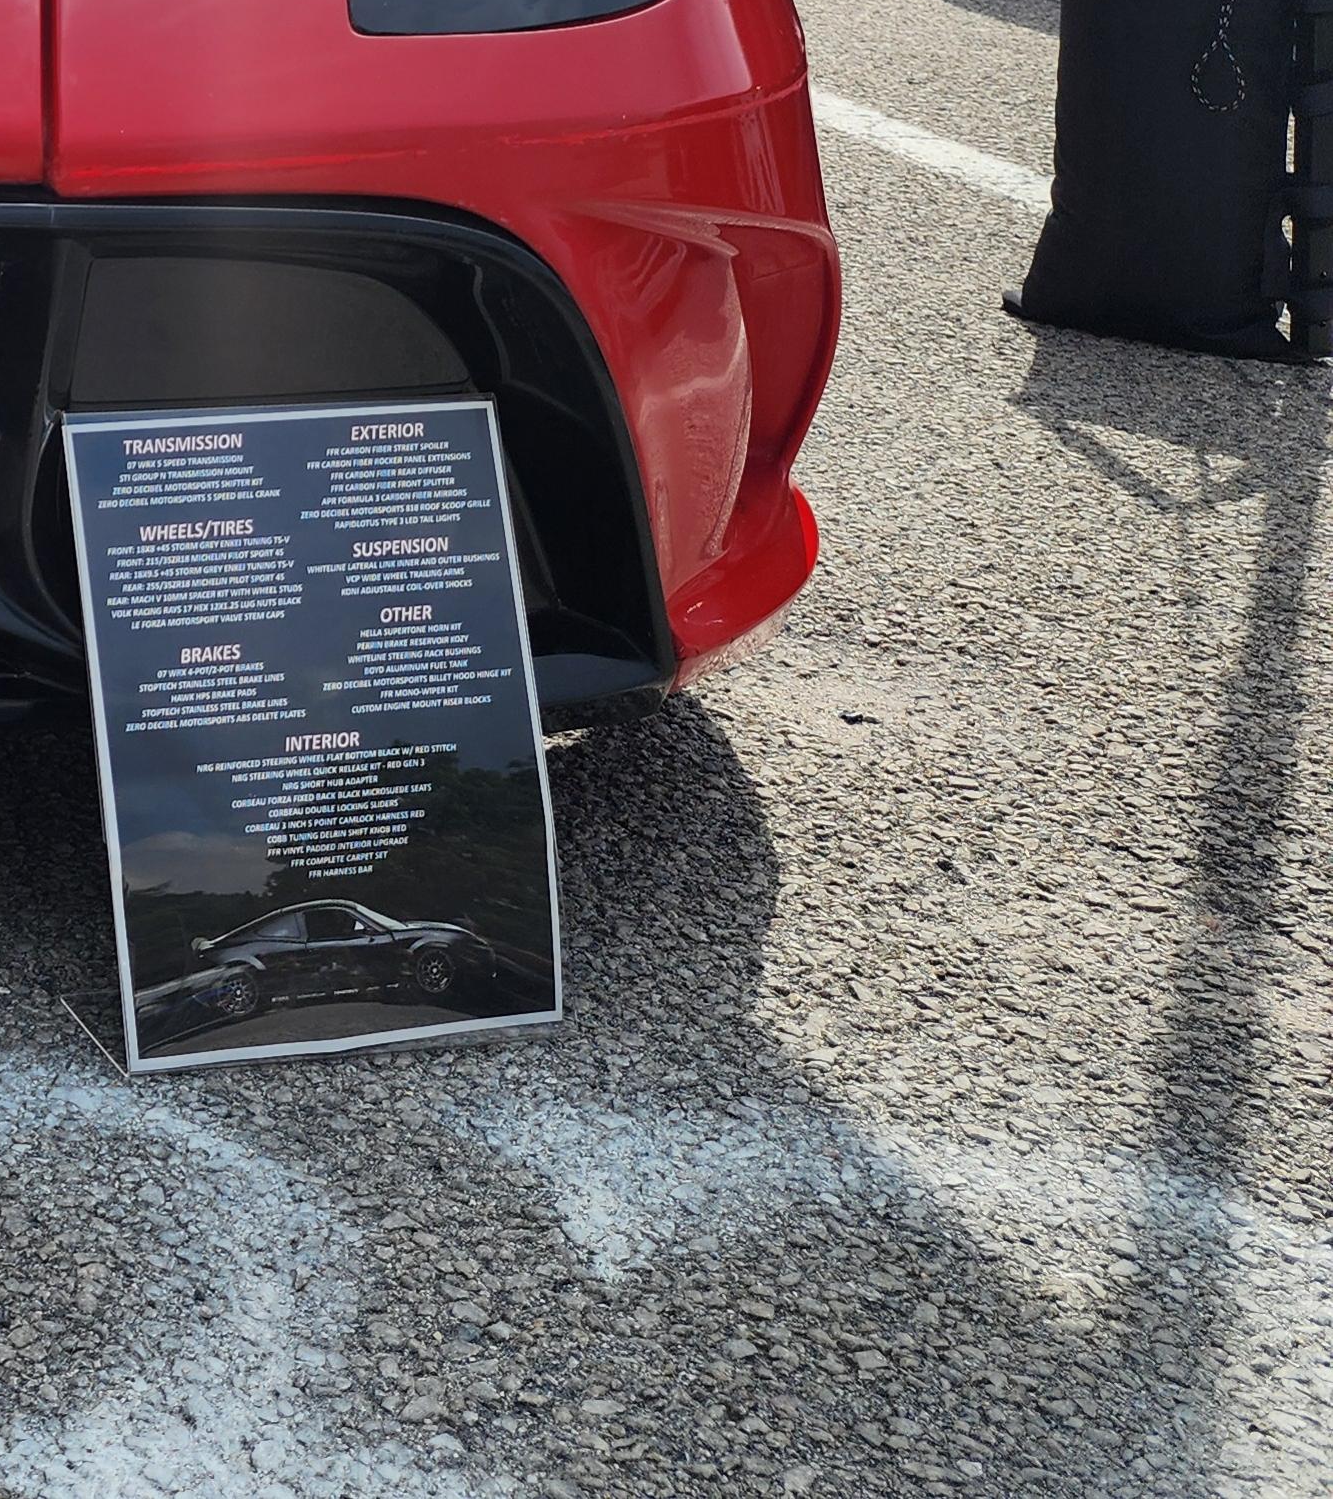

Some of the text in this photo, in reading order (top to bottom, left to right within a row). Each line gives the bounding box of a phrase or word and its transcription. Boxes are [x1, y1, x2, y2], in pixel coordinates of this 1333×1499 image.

[350, 422, 424, 441] EXTERIOR
[123, 433, 242, 454] TRANSMISSION
[139, 518, 253, 541] WHEELS/TIRES
[352, 536, 448, 557] SUSPENSION
[306, 552, 500, 574] WHITELINE LATERAL LINK INNER AND OUTER BUSHINGS
[379, 604, 432, 623] OTHER
[180, 643, 241, 664] BRAKES
[138, 672, 285, 693] STOPTECH STAINLESS STEEL BRAKE LINES
[285, 731, 359, 751] INTERIOR
[214, 758, 261, 771] REINFORCED
[261, 755, 297, 767] STEERING
[297, 753, 325, 764] WHEEL
[325, 751, 344, 761] FLAT
[344, 749, 377, 760] BOTTOM
[376, 747, 400, 757] BLACK
[414, 744, 430, 754] RED
[430, 742, 457, 753] STITCH
[230, 782, 432, 808] CORBEAU FORZA FIXED BACK BLACK MICROSUEDE SEATS
[305, 854, 345, 866] COMPLETE
[345, 851, 374, 862] CARPET
[374, 849, 388, 859] SET
